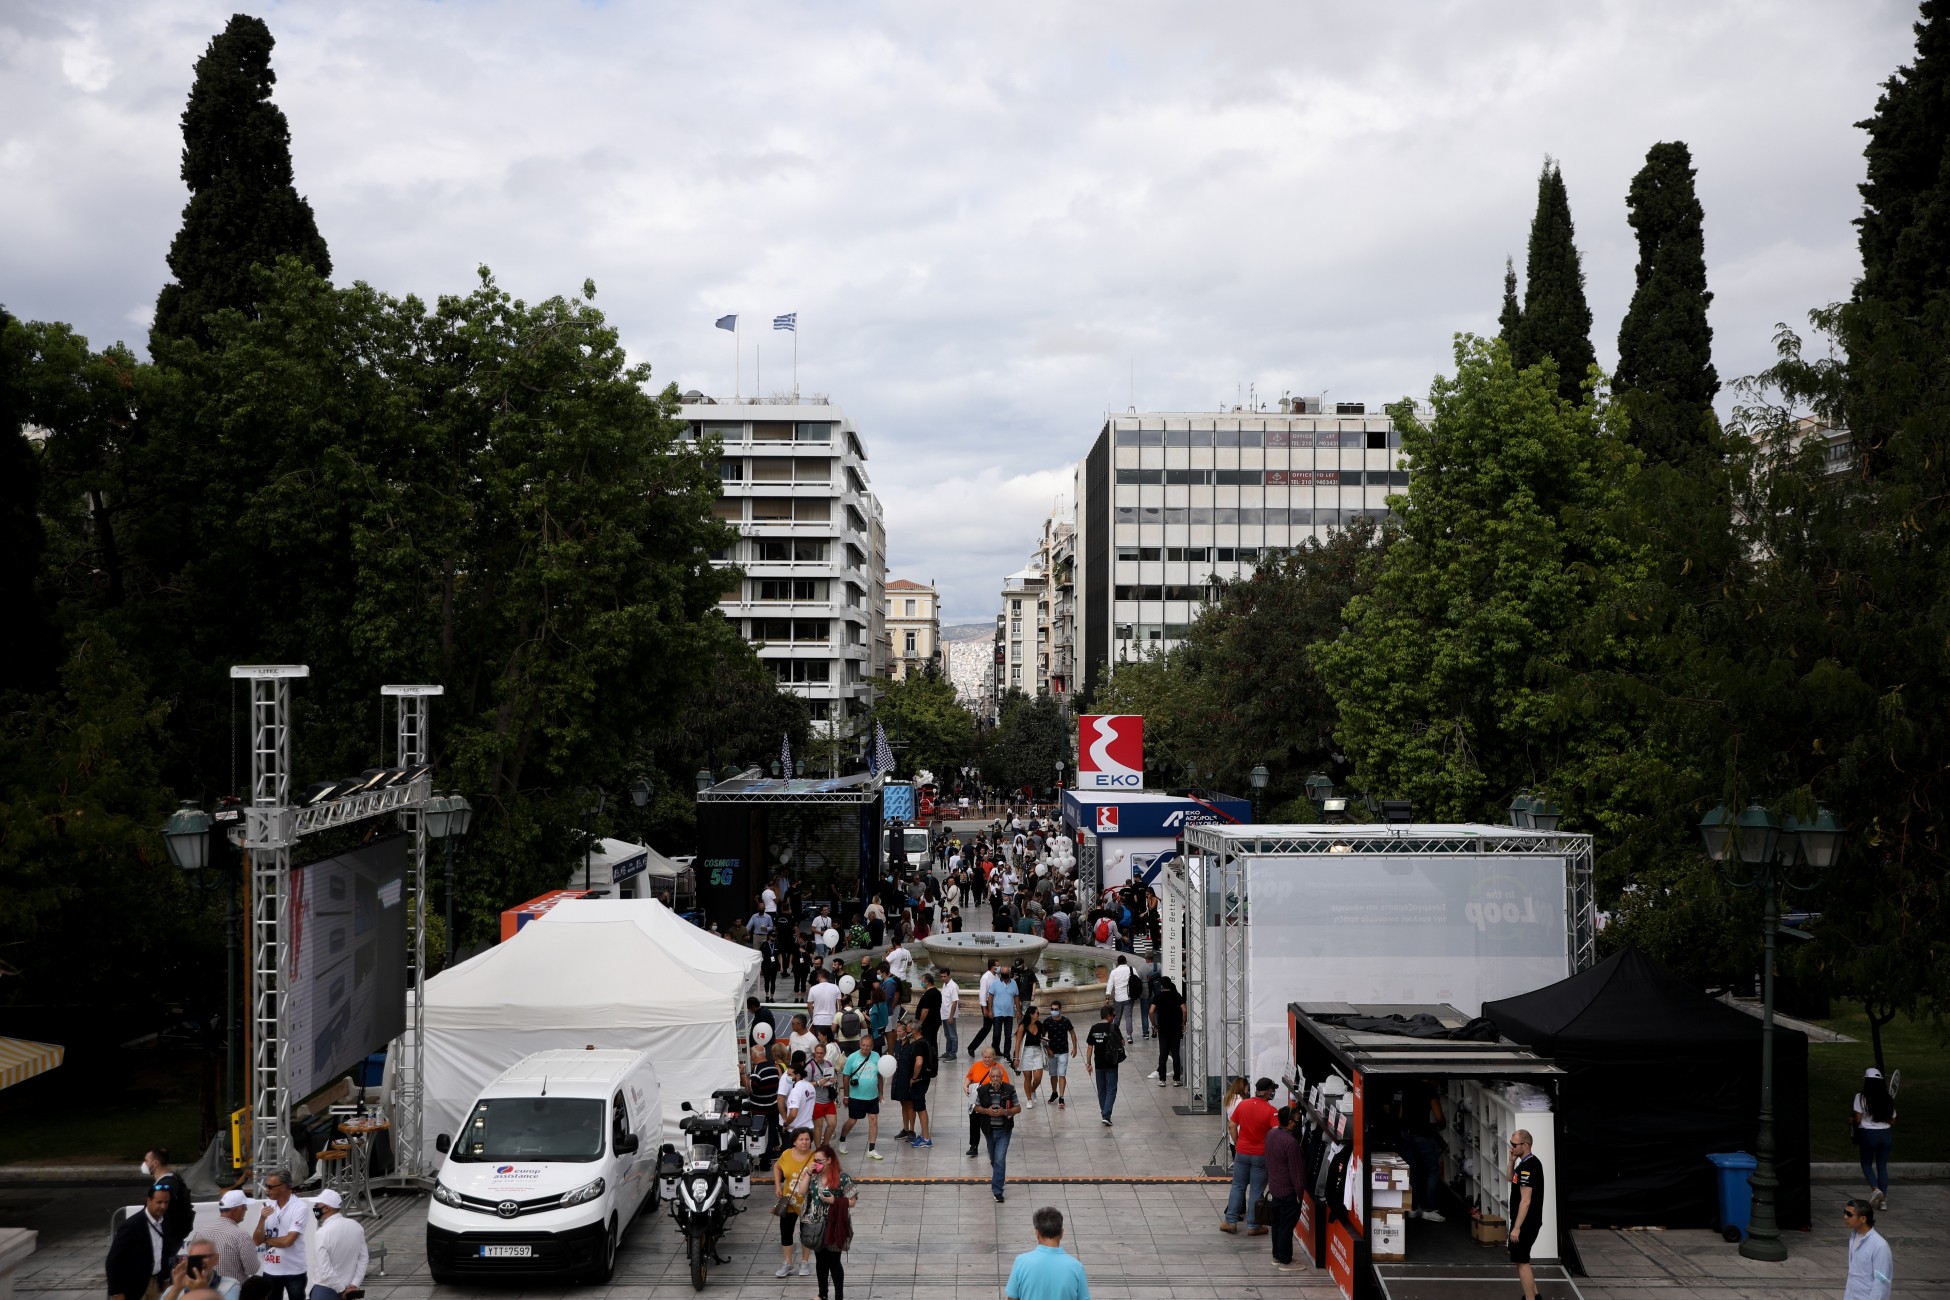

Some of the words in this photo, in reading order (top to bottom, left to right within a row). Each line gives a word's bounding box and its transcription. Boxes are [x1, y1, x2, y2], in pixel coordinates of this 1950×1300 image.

[1096, 775, 1140, 786] EKO
[704, 858, 741, 868] COSMOTE
[710, 867, 734, 886] 5G
